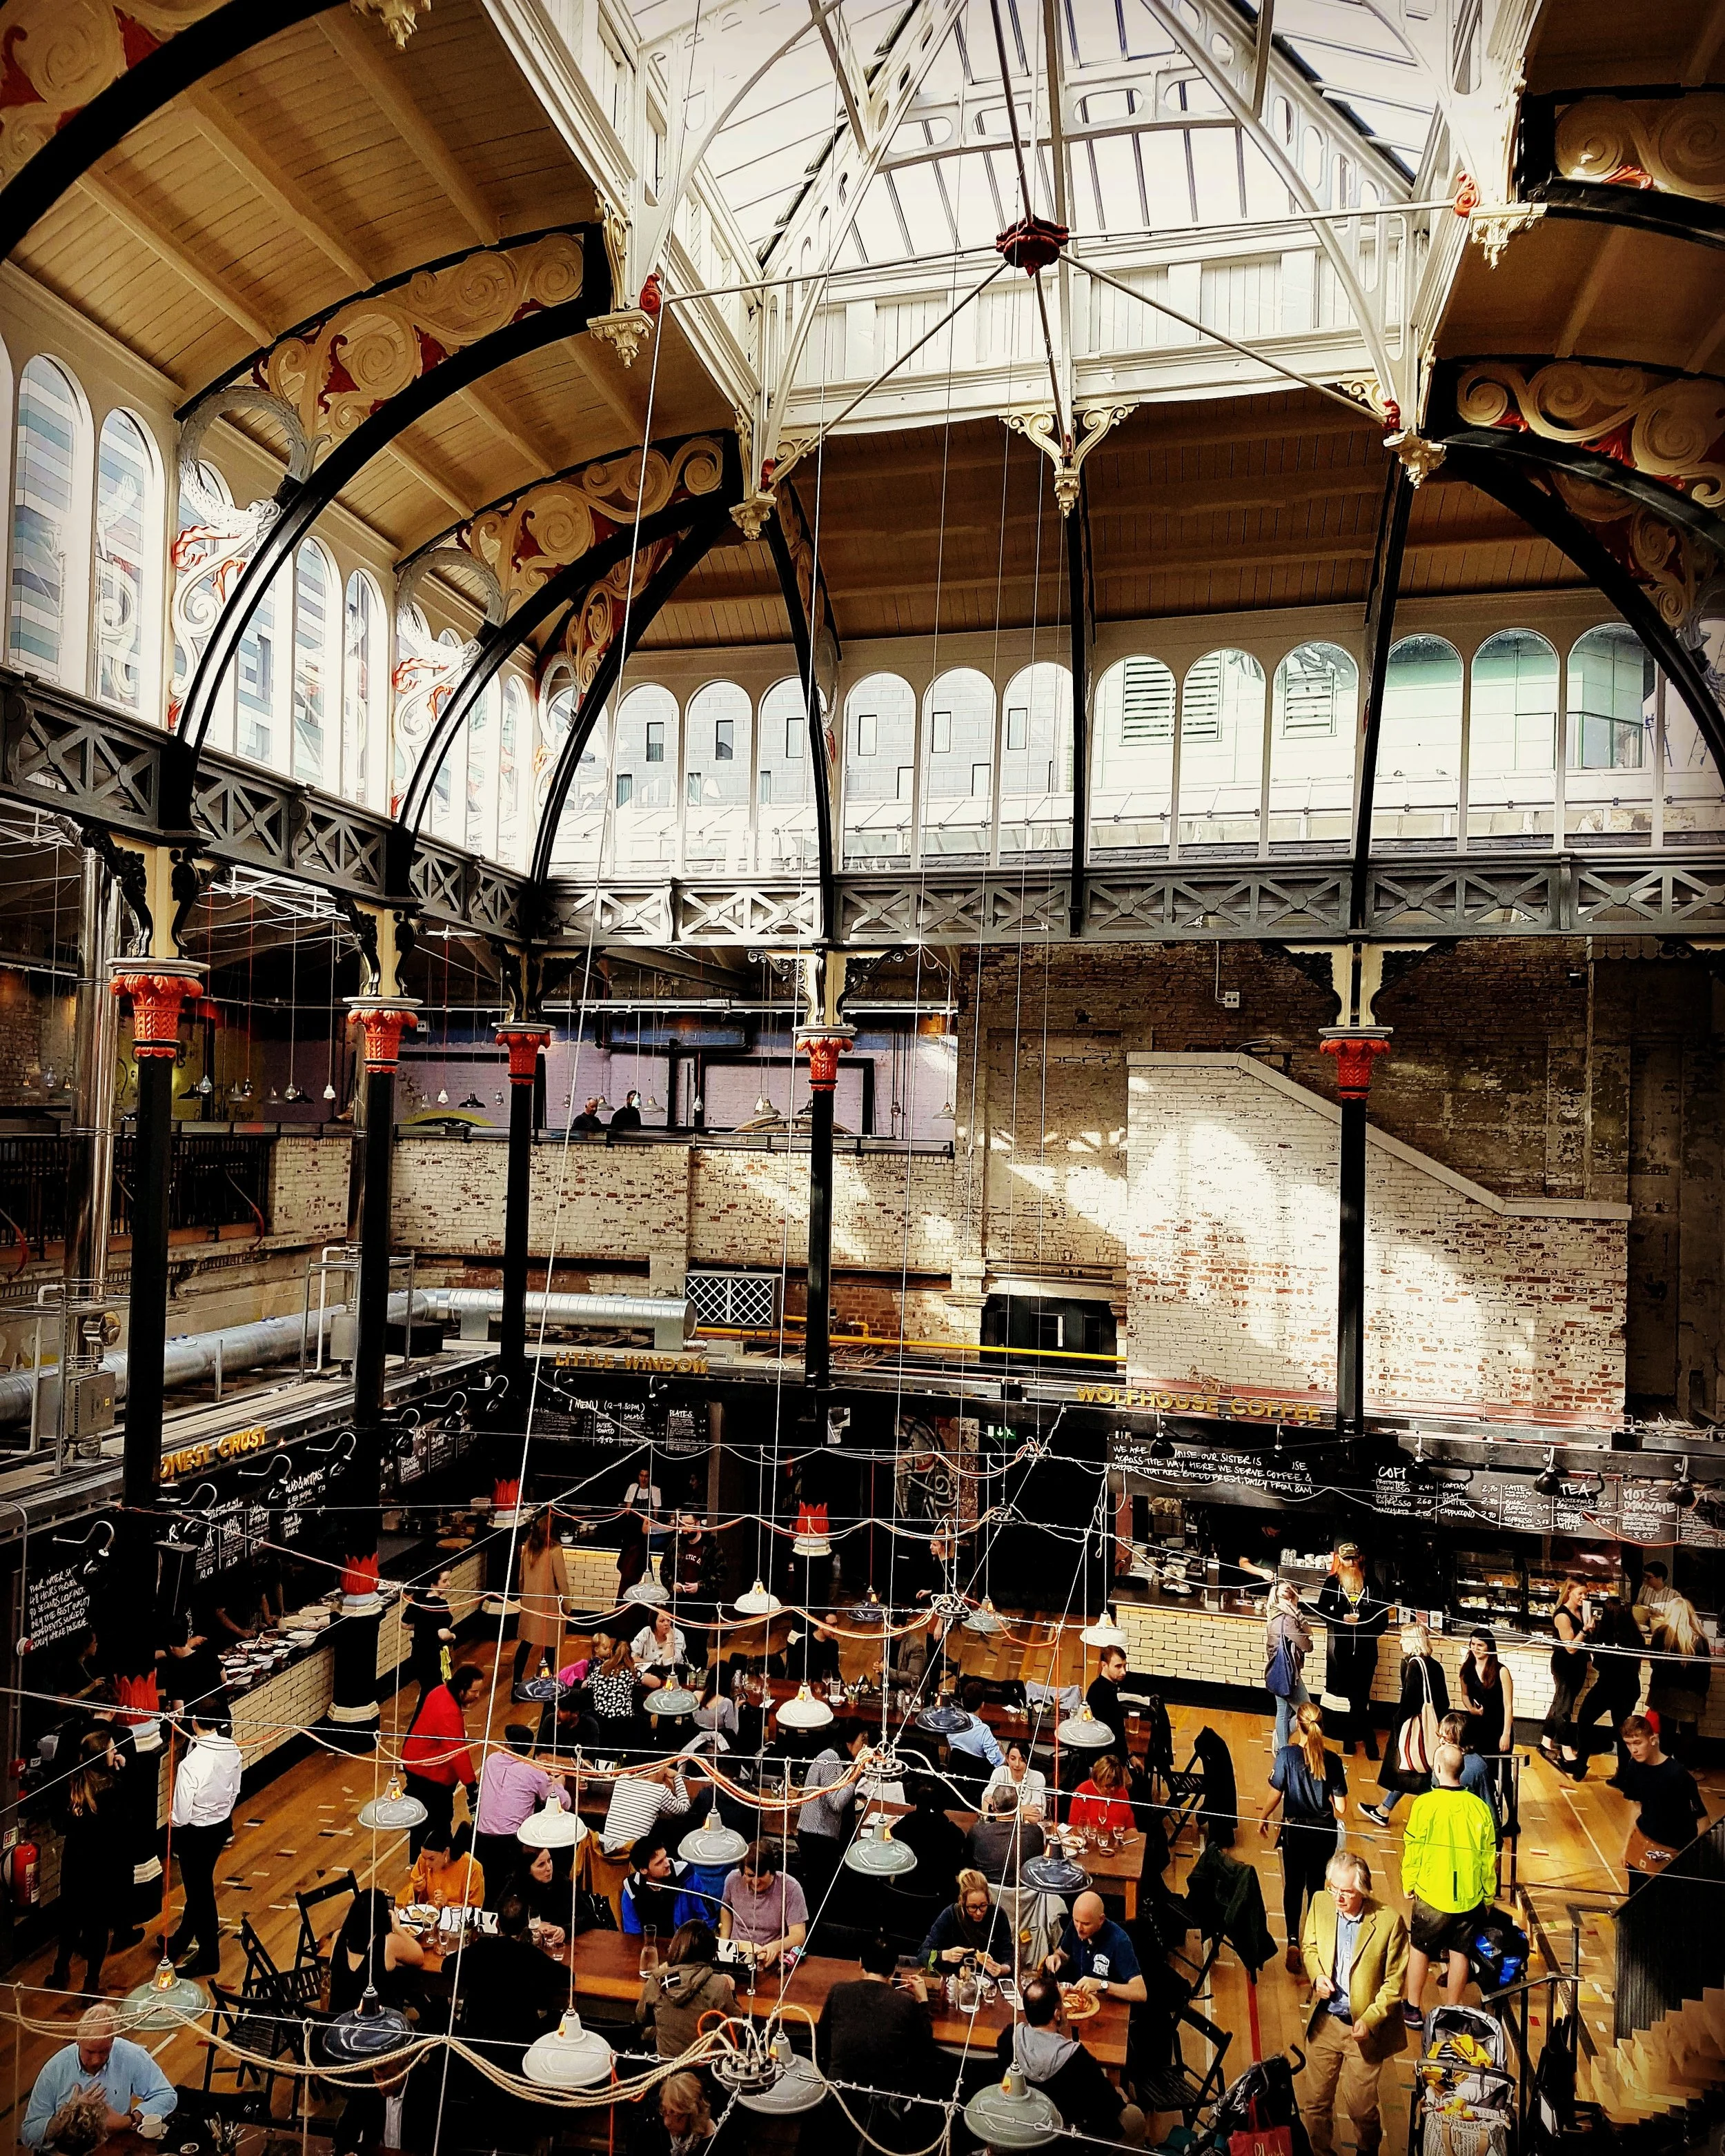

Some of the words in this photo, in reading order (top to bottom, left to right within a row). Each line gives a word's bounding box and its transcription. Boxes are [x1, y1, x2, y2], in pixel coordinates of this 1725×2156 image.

[556, 1352, 615, 1368] LITTLE
[624, 1355, 709, 1374] WINDOW
[1077, 1385, 1219, 1412] WOLFHOUSE
[1231, 1398, 1320, 1420] COFFEE
[160, 1443, 213, 1478] ONEST
[217, 1426, 267, 1458] CRUST
[1113, 1445, 1127, 1453] WE
[1130, 1446, 1149, 1454] ARE
[1201, 1453, 1219, 1461] OUR
[1221, 1453, 1252, 1464] SISTER
[1253, 1457, 1261, 1465] IS
[1114, 1454, 1143, 1465] ACROSS
[1190, 1461, 1216, 1470] HERE
[1234, 1466, 1265, 1476] SERVE
[1267, 1470, 1302, 1481] COFFEE
[1305, 1473, 1312, 1484] &
[1271, 1481, 1292, 1492] FROM
[1560, 1483, 1593, 1497] TEA
[1623, 1488, 1648, 1501] HOT
[30, 1594, 39, 1605] 48
[30, 1608, 36, 1620] 90
[44, 1611, 56, 1622] THE
[57, 1602, 72, 1616] BEST
